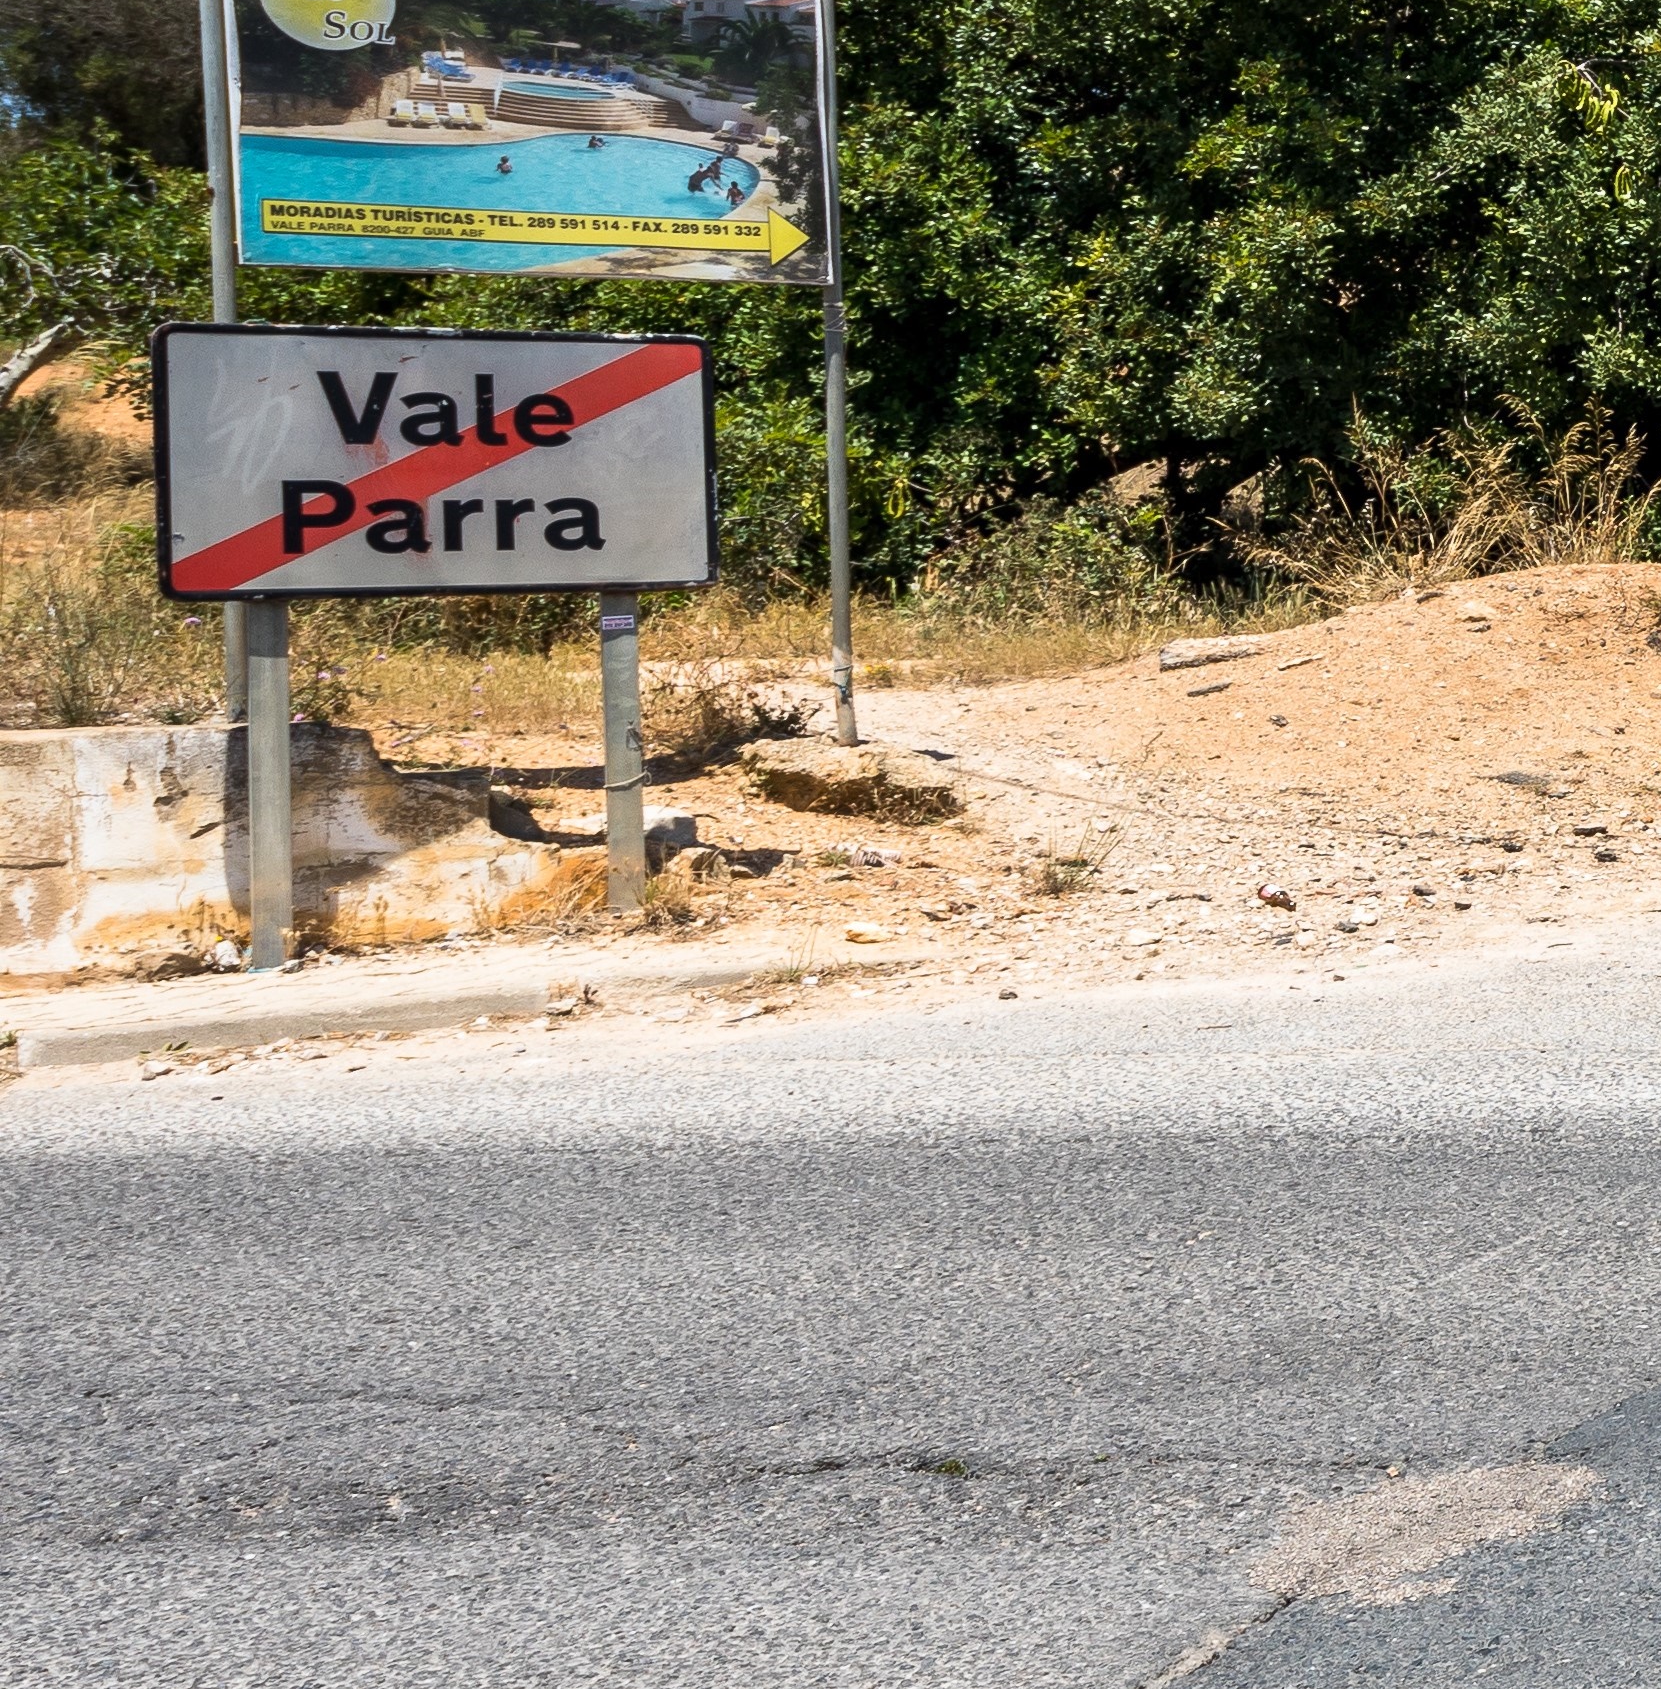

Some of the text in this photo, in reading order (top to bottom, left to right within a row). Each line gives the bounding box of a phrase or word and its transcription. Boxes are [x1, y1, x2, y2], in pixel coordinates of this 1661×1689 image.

[269, 204, 366, 221] MORADIAS
[370, 207, 475, 226] TURÍSTICAS
[487, 214, 523, 228] TEL.
[527, 216, 556, 229] 289
[560, 218, 586, 230] 591
[592, 219, 620, 231] 514
[632, 220, 668, 233] FAX.
[671, 222, 700, 235] 289
[703, 224, 729, 236] 591
[735, 225, 761, 237] 332
[271, 220, 305, 231] VALE
[310, 222, 356, 233] PARRA
[422, 226, 455, 236] GUIA
[316, 370, 576, 449] Vale
[279, 478, 607, 556] Parra
